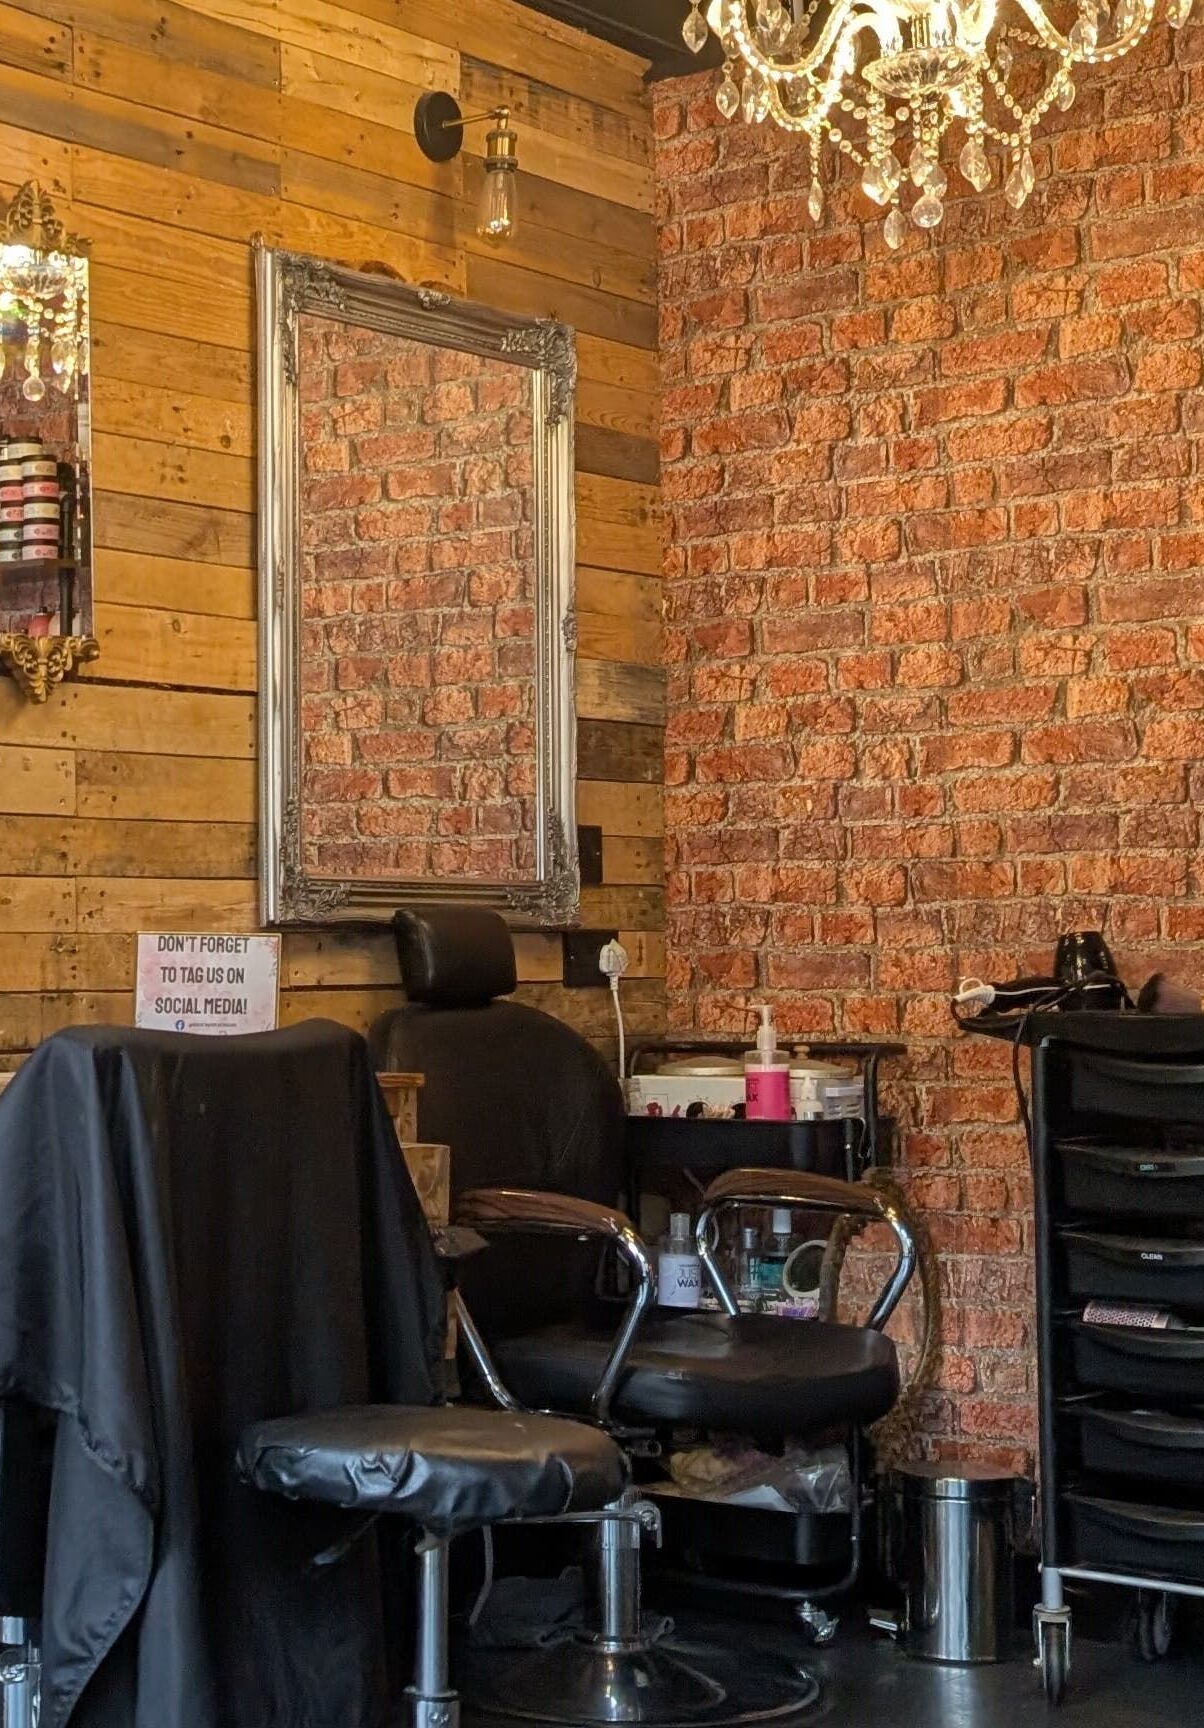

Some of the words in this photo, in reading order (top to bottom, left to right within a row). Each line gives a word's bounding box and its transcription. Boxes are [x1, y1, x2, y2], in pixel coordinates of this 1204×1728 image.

[158, 936, 198, 952] DON'T
[200, 937, 250, 953] FORGET
[160, 966, 177, 983] TO
[180, 967, 204, 983] TAG
[206, 967, 224, 983] US
[227, 967, 245, 984] ON
[155, 997, 201, 1014] SOCIAL
[204, 998, 248, 1015] MEDIA!
